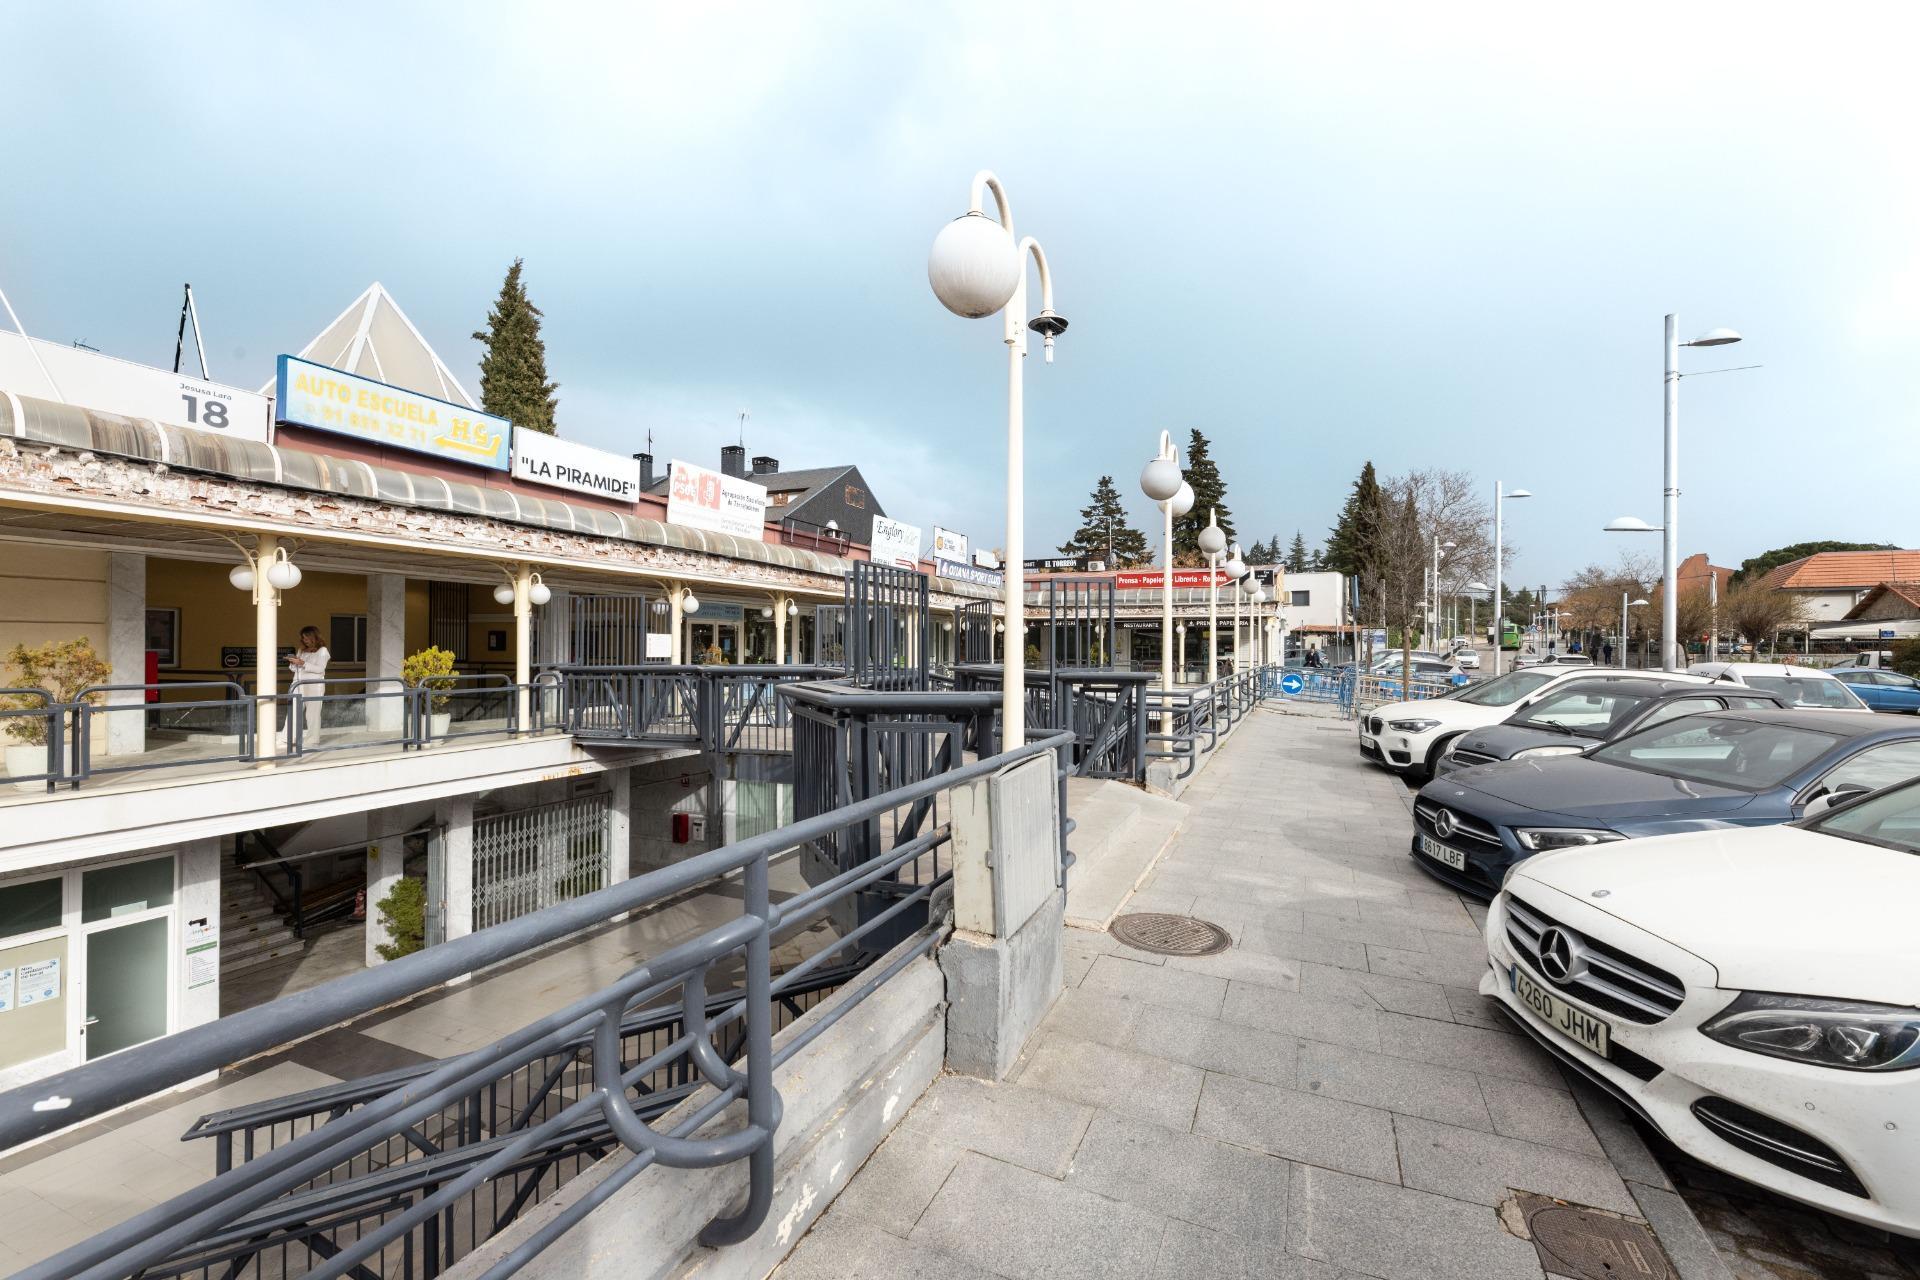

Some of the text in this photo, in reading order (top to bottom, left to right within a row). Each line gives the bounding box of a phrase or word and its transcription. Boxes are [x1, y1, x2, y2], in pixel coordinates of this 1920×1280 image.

[182, 394, 230, 429] 18
[213, 391, 232, 401] Lara
[295, 373, 439, 427] AUTO ESCUELA
[521, 456, 636, 496] "LA PIRAMIDE"
[971, 569, 987, 583] SPORT
[1443, 847, 1462, 866] LBF
[1517, 975, 1600, 1049] 4260 JHM
